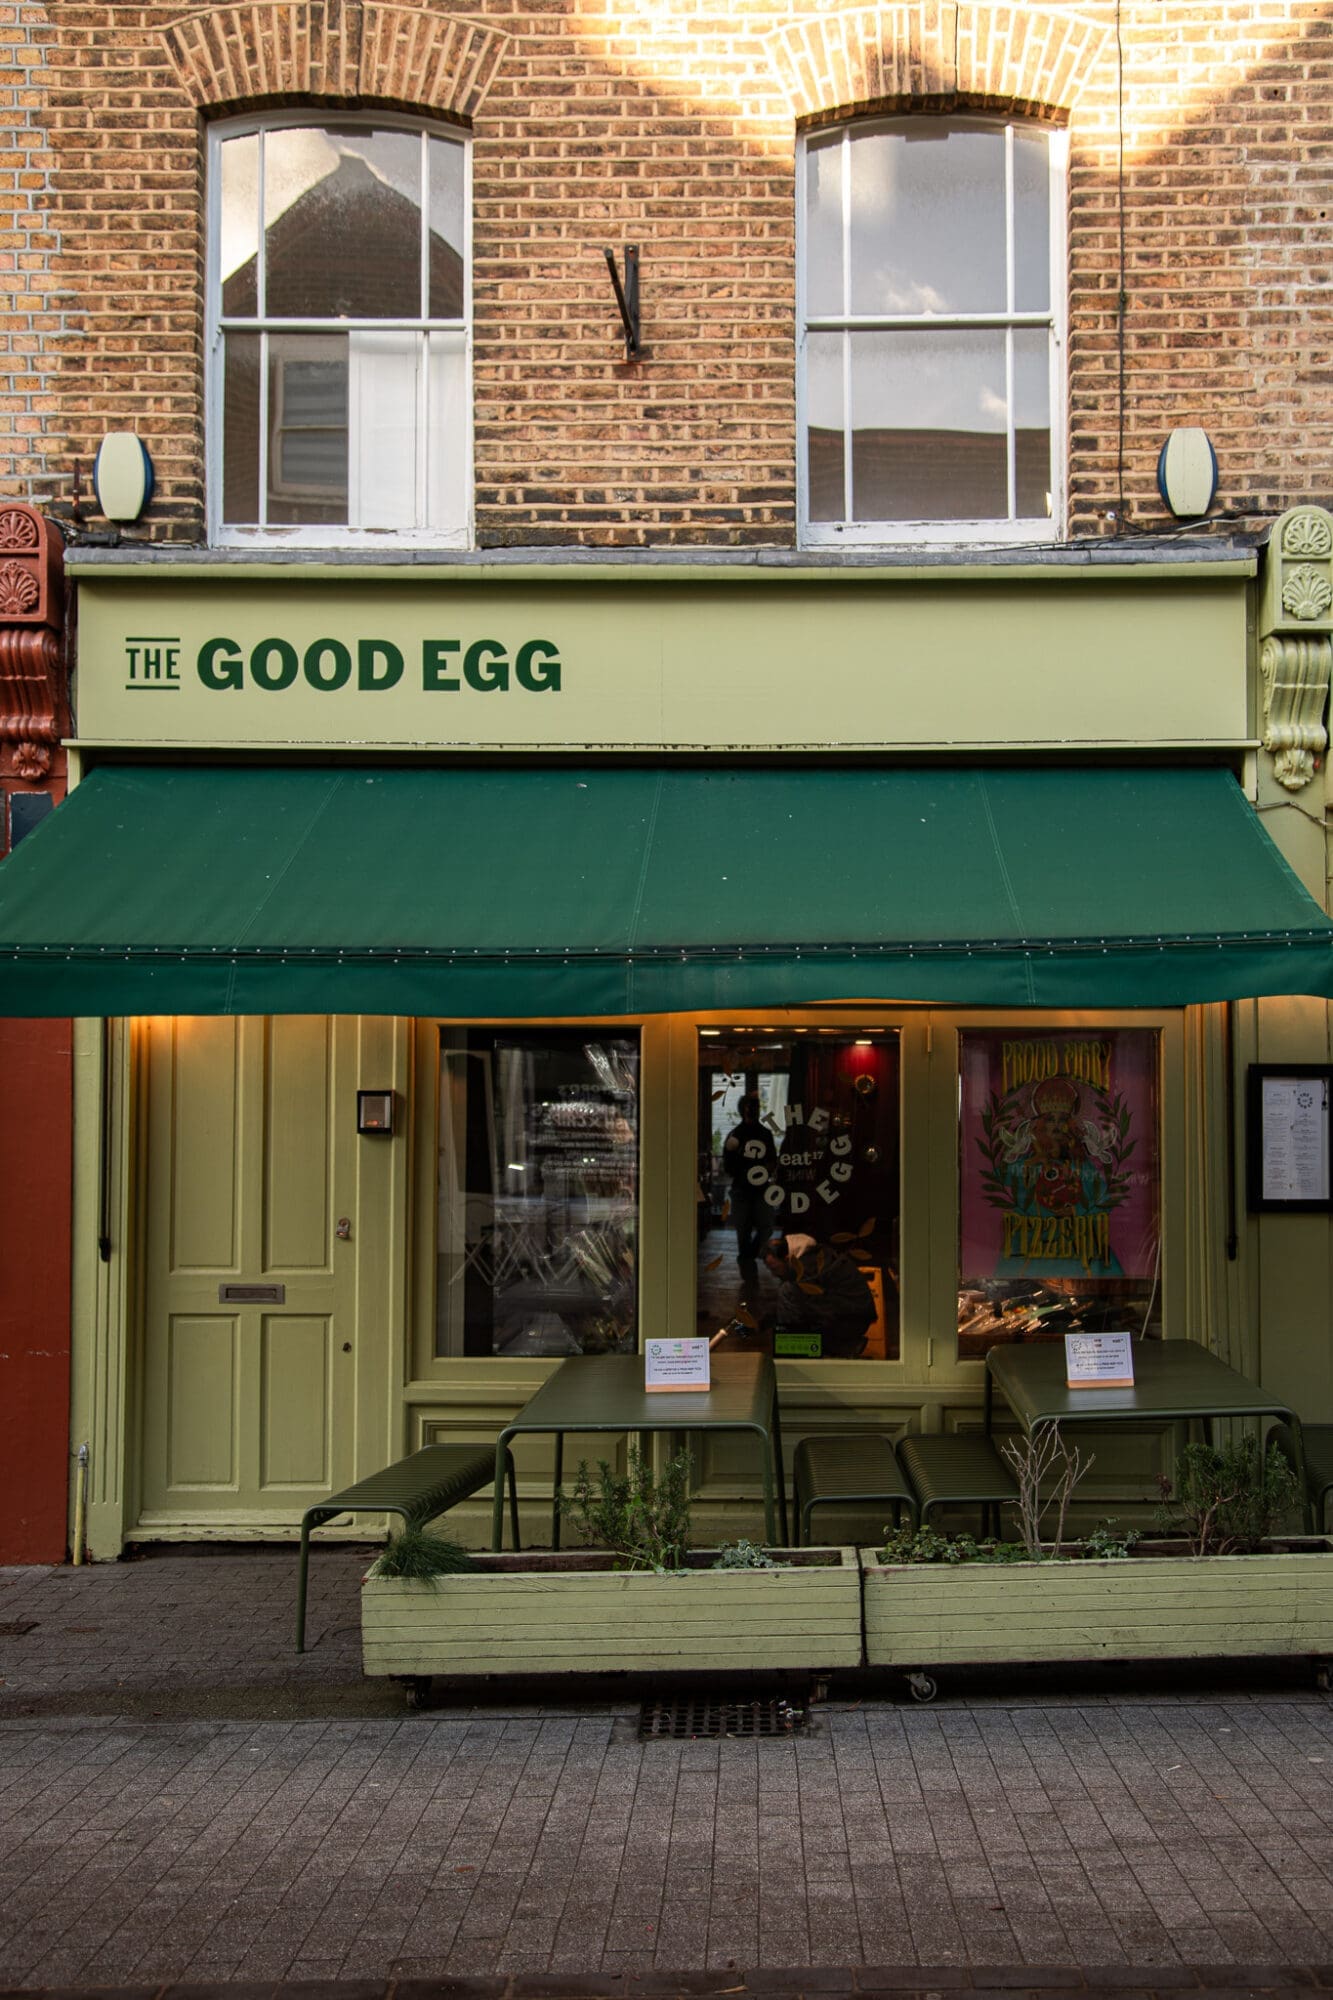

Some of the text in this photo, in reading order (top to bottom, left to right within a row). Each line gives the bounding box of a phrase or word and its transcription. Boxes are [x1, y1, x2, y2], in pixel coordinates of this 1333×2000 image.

[125, 637, 562, 692] THE GOOD EGG
[1002, 1040, 1060, 1096] PROUD
[760, 1104, 830, 1136] THE
[744, 1134, 854, 1214] GOOD EGG
[1003, 1212, 1110, 1268] PIZZERIA
